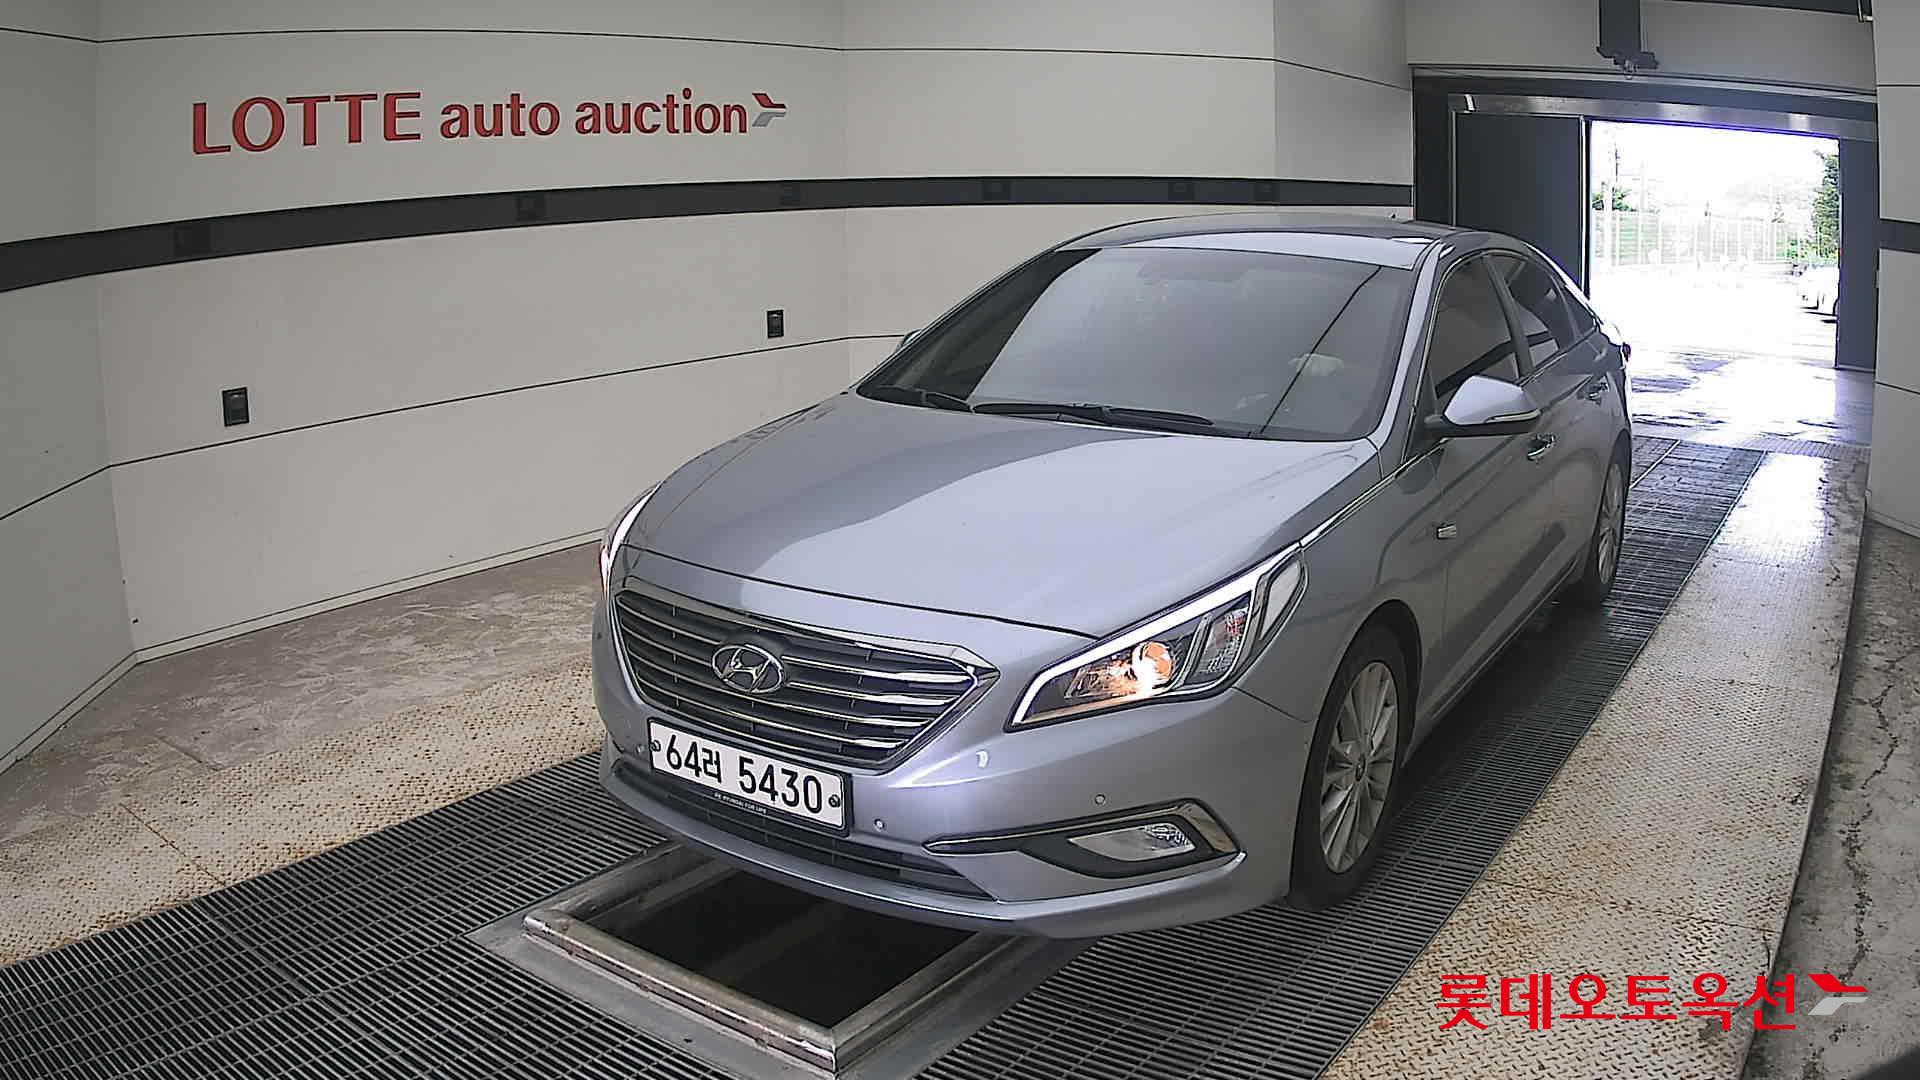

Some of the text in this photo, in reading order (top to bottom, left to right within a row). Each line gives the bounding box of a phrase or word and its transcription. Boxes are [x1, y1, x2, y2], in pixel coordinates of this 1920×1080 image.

[192, 87, 747, 154] LOTTE auto auction
[666, 734, 822, 814] 64러 5430
